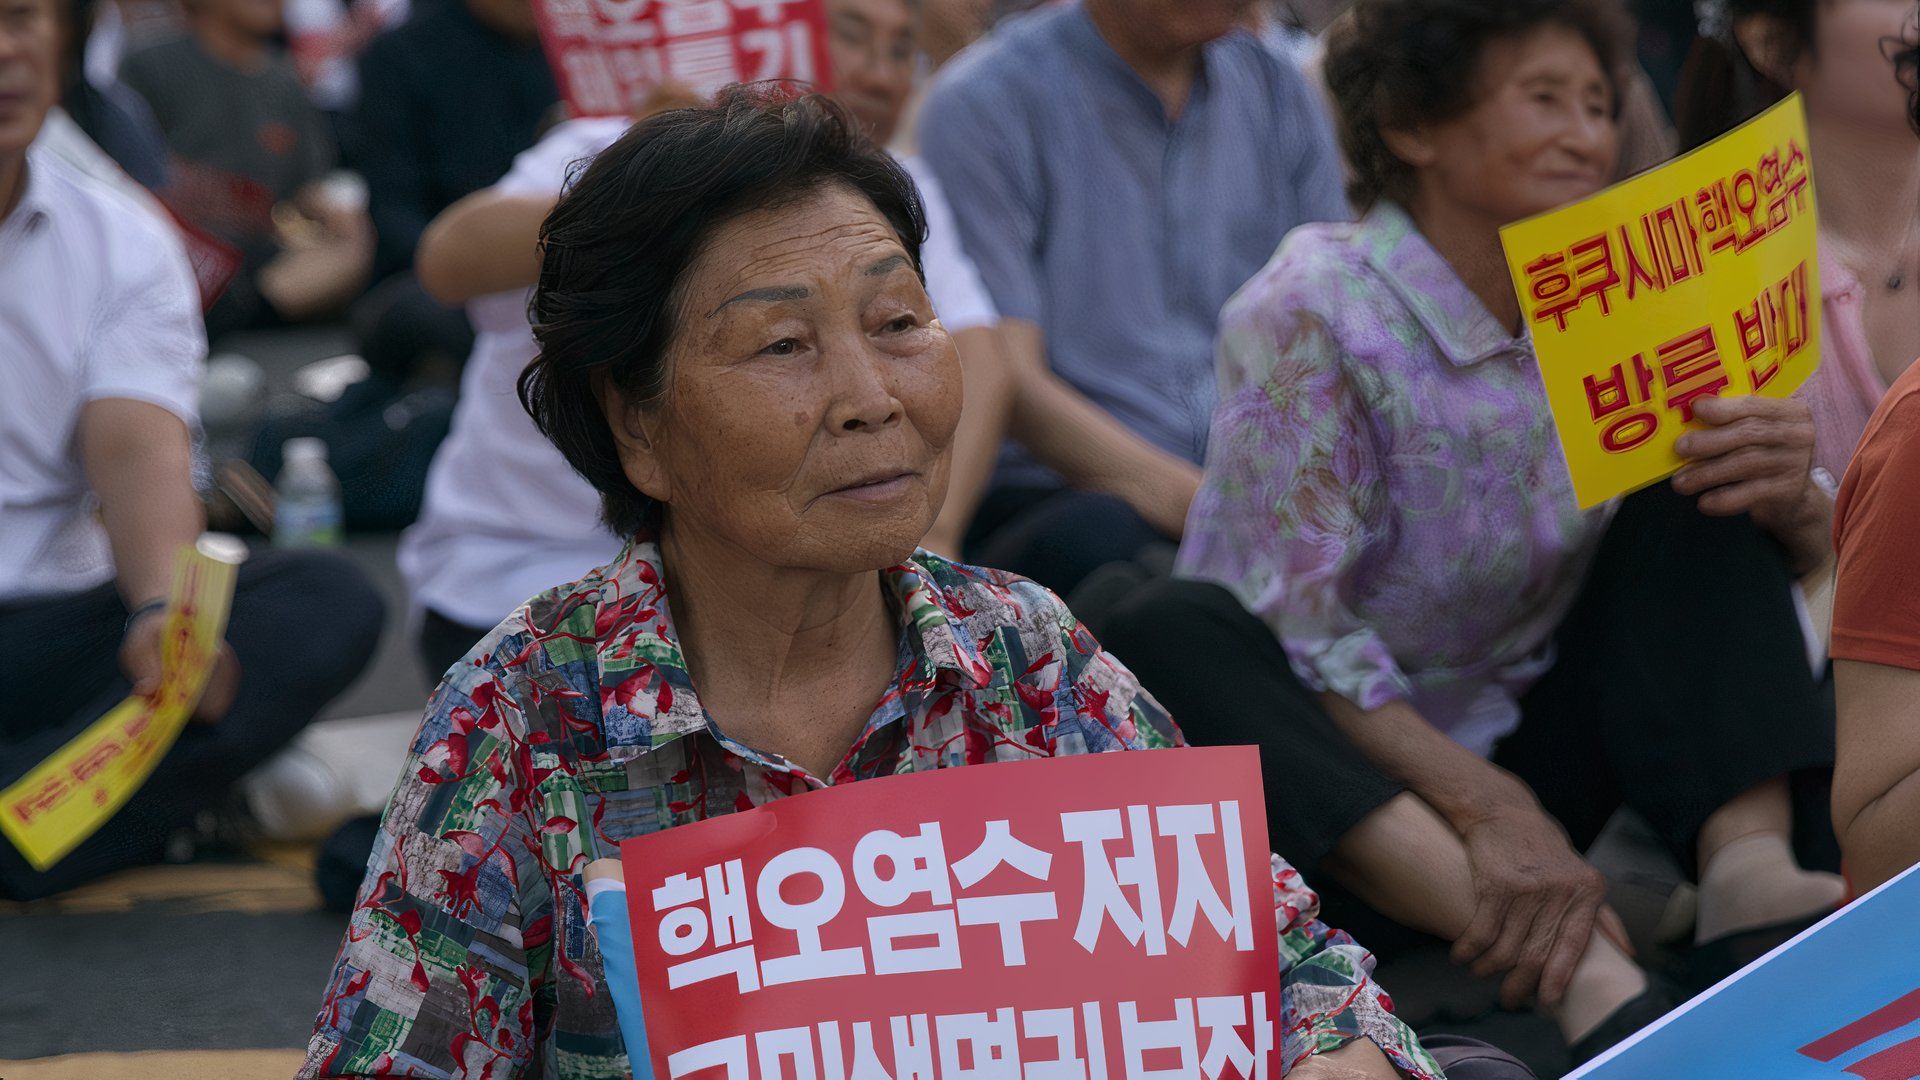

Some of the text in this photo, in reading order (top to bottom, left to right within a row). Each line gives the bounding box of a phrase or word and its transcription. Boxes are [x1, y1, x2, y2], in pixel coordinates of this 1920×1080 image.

[1524, 197, 1704, 333] 후쿠시마
[652, 800, 1255, 994] 핵오염수 저지
